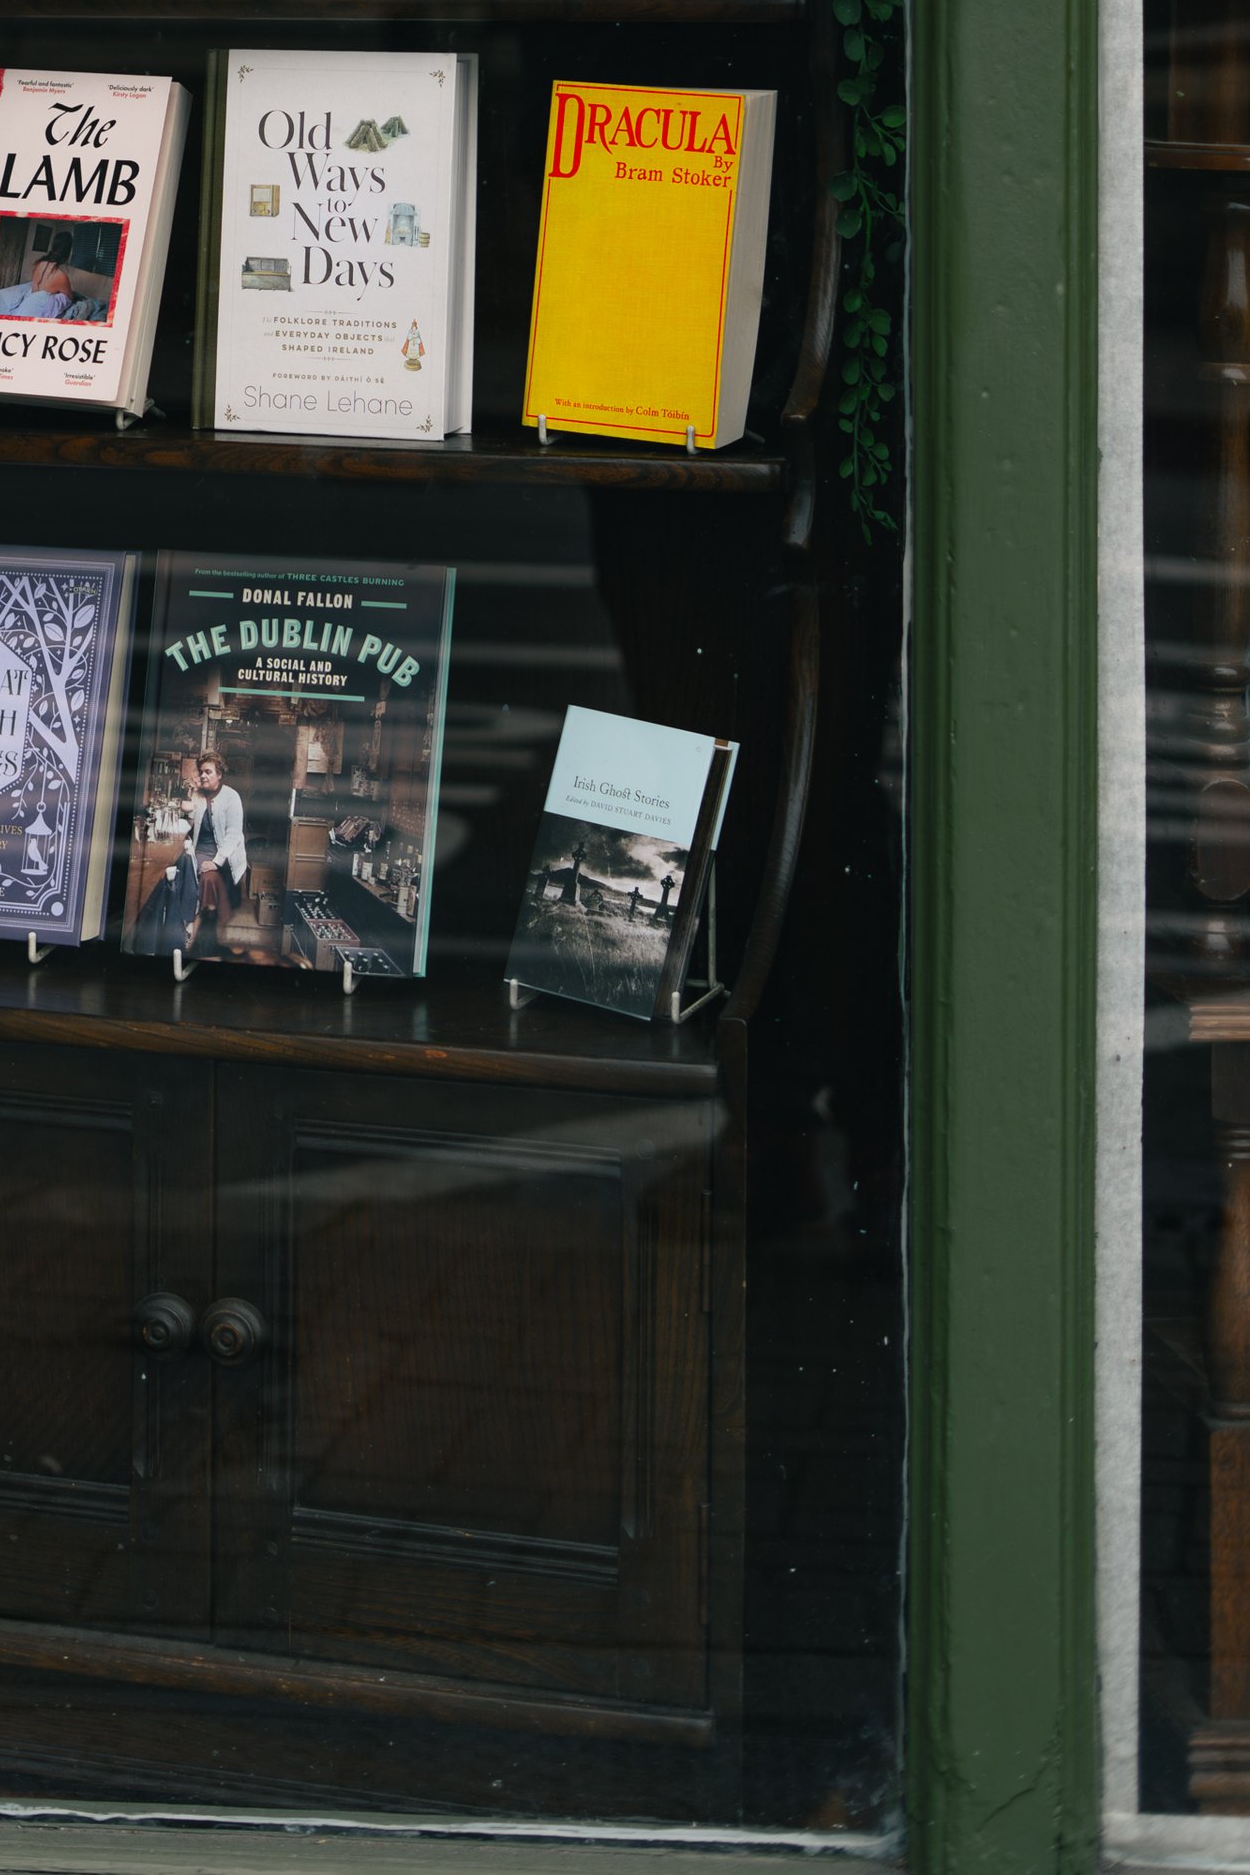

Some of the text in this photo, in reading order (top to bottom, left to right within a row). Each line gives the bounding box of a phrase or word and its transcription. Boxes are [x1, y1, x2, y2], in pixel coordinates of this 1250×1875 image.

[44, 102, 117, 148] The
[258, 109, 332, 151] Old
[549, 92, 737, 179] DRACULA
[286, 152, 386, 204] Ways
[614, 161, 732, 188] Bram Stoker
[713, 156, 734, 174] By
[327, 197, 348, 214] to
[291, 202, 378, 244] New
[302, 246, 395, 301] Days
[274, 317, 327, 326] FOLKLORE
[332, 319, 397, 328] TRADITIONS
[275, 330, 330, 339] EVERYDAY
[335, 333, 383, 341] OBJECTS
[41, 335, 108, 364] ROSE
[282, 344, 374, 355] SHAPED IRELAND
[243, 385, 414, 417] Shane Lehane
[555, 398, 571, 407] With
[583, 402, 624, 413] introduction
[626, 406, 634, 415] by
[636, 406, 659, 417] Colm
[662, 409, 690, 420] Tóibín
[223, 570, 256, 578] bestselling
[287, 573, 317, 581] THREE
[320, 574, 359, 584] CASTLES
[362, 577, 405, 586] BURNING
[242, 588, 353, 609] DONAL FALLON
[164, 617, 421, 688] THE DUBLIN PUB
[256, 657, 332, 672] A SOCIAL AND
[238, 669, 348, 686] CULTURAL HISTORY
[573, 776, 670, 809] Irish Ghost Stories
[566, 795, 583, 805] Edited
[590, 800, 612, 811] DAVID
[615, 806, 643, 819] STUART
[644, 813, 671, 825] DAVIES
